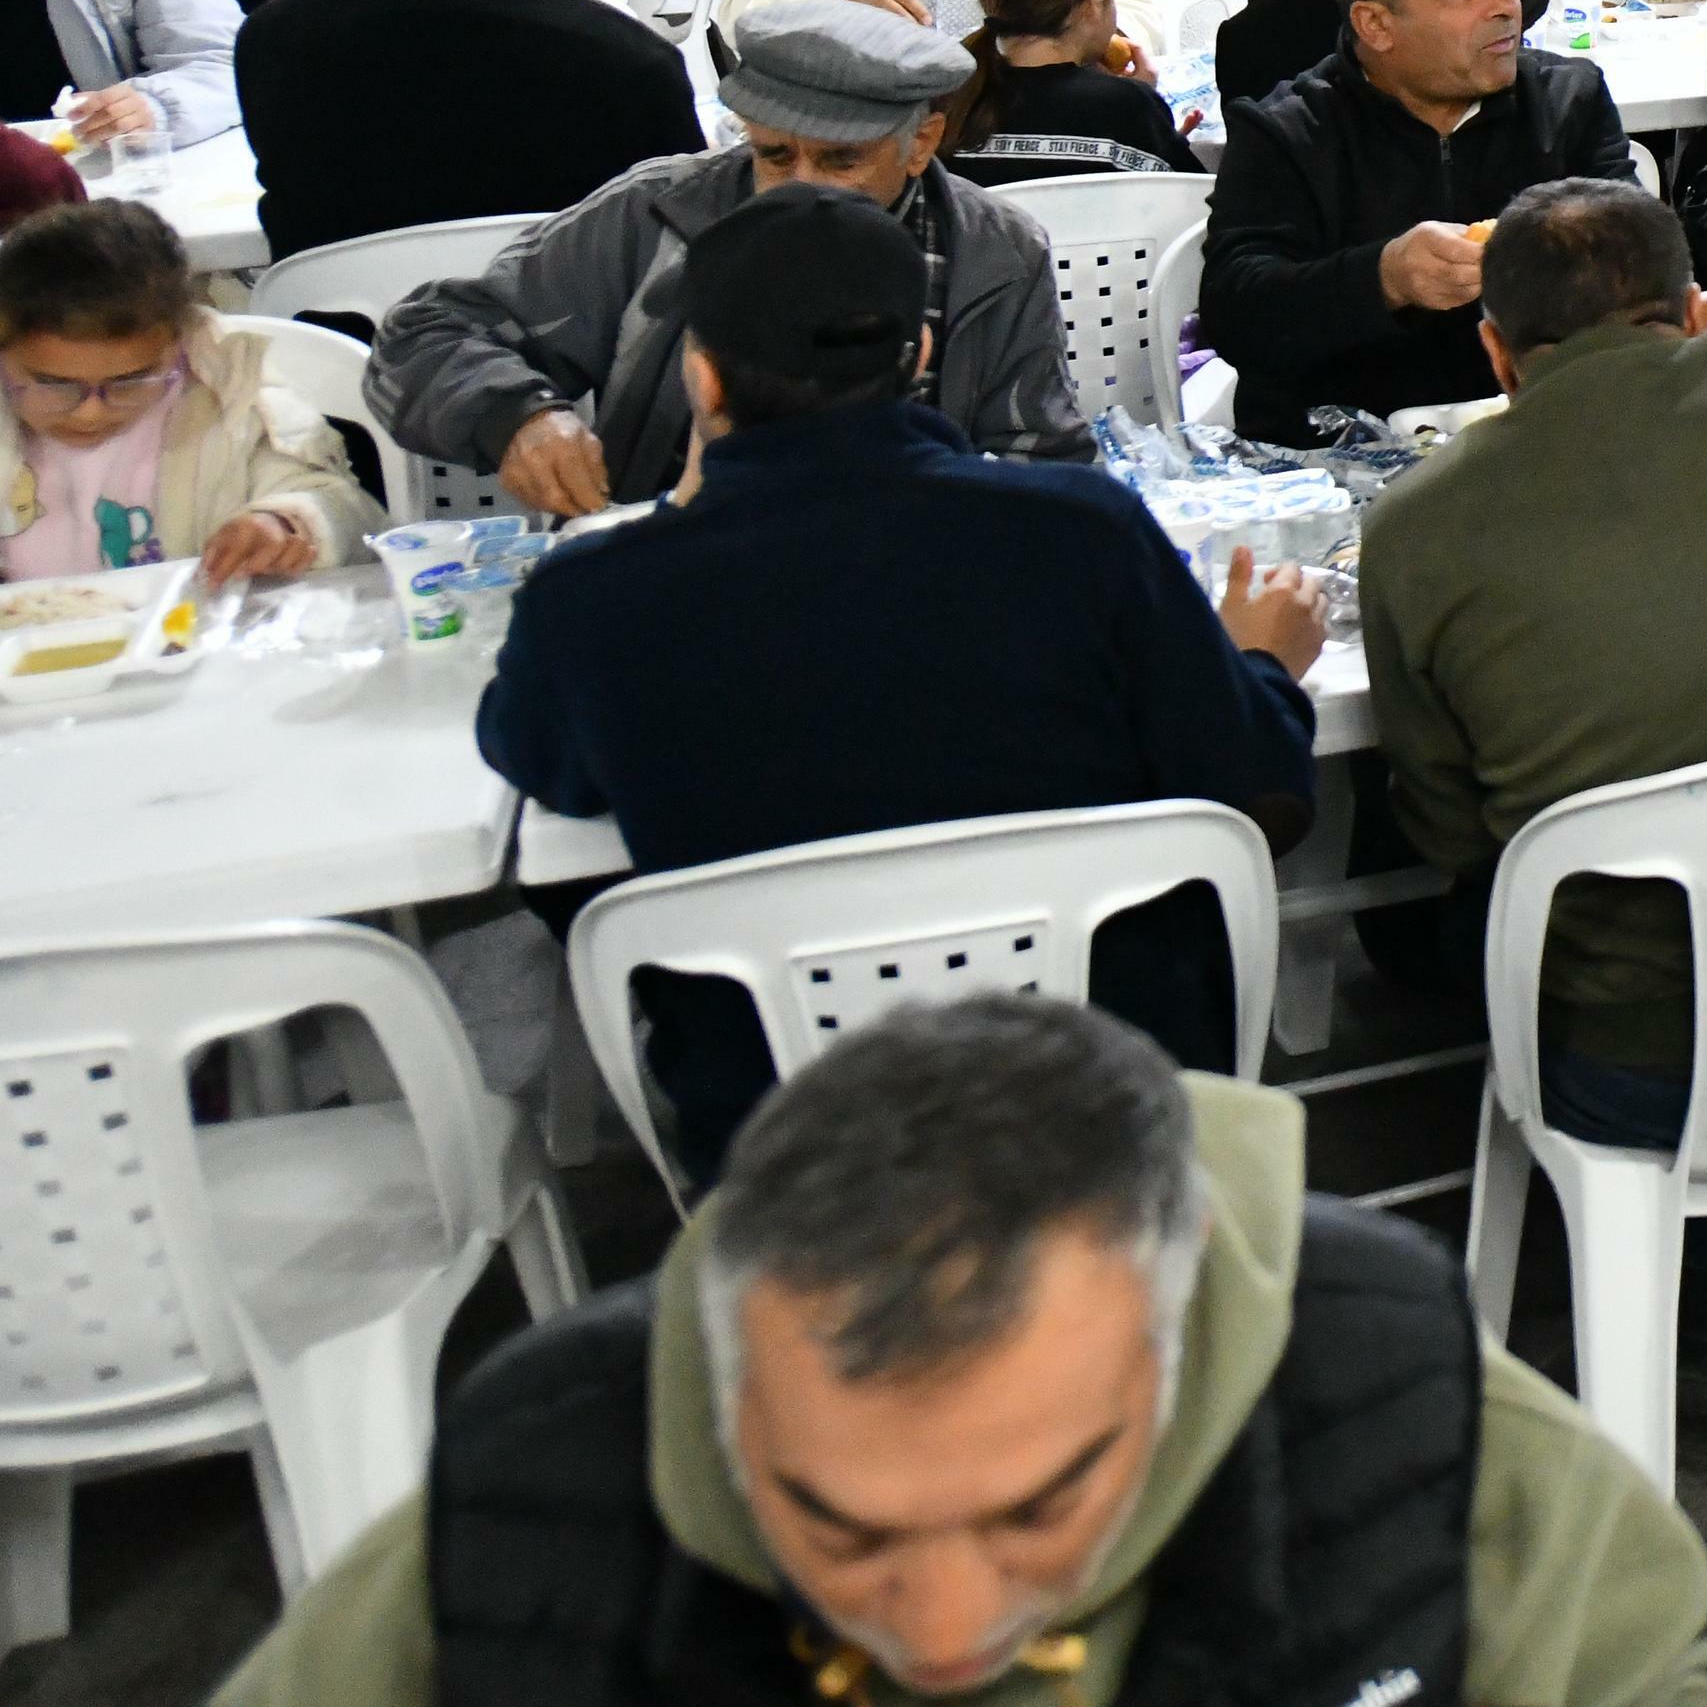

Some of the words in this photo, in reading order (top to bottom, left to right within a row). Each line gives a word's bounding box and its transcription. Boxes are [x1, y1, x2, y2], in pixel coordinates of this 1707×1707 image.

[1013, 140, 1040, 153] FIERCE
[1048, 140, 1068, 153] STAY
[1070, 141, 1099, 155] FIERCE
